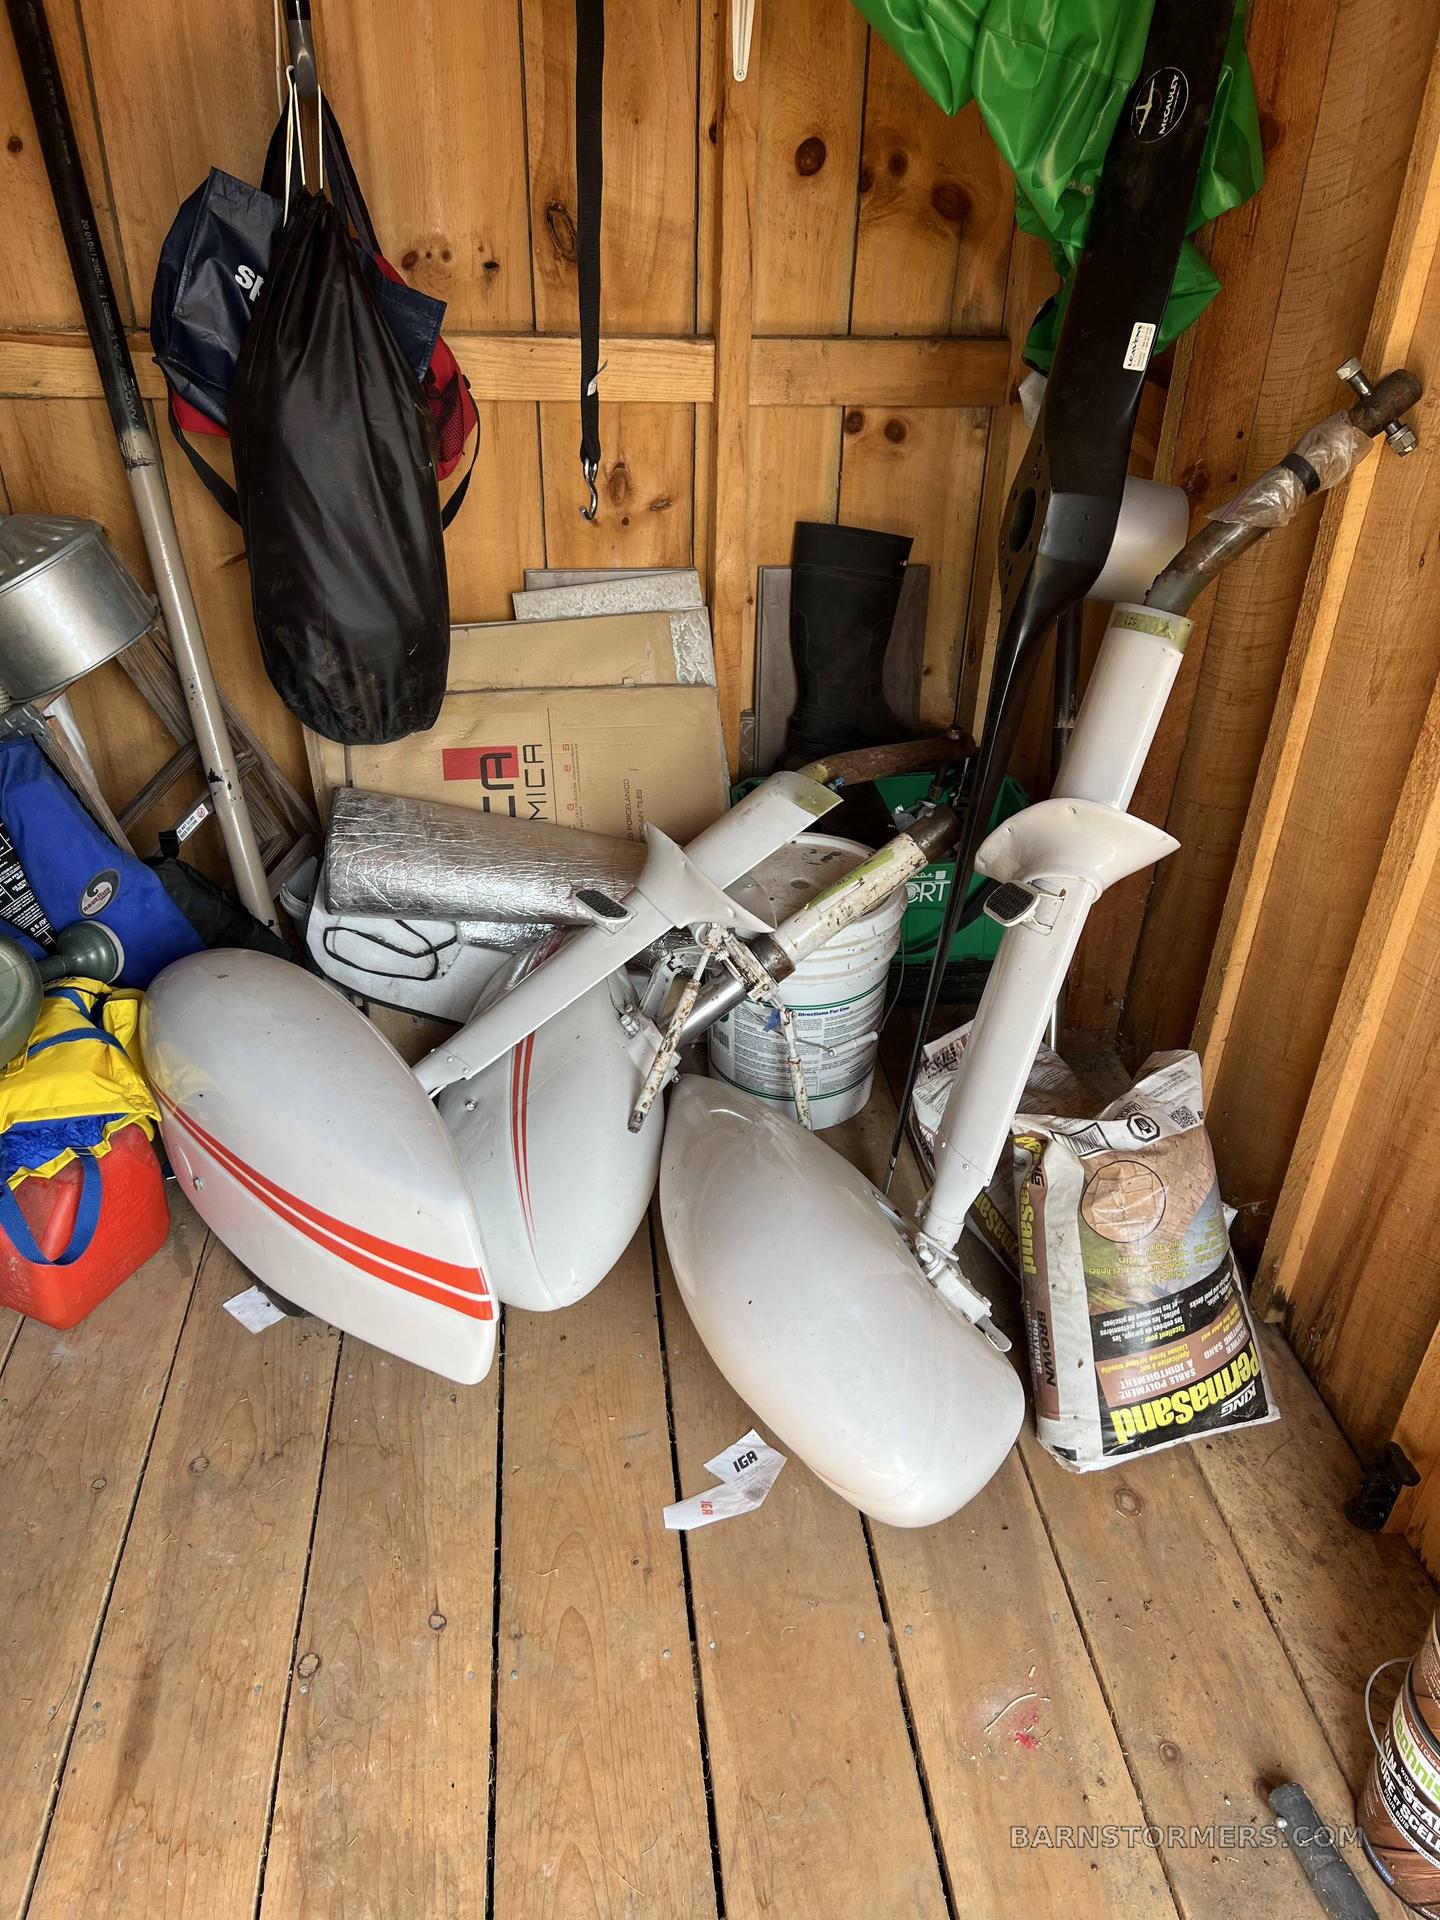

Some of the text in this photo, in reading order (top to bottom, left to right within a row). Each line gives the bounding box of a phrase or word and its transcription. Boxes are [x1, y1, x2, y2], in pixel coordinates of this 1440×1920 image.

[1088, 1268, 1111, 1277] herbes
[1162, 1303, 1171, 1312] les
[1189, 1296, 1205, 1309] decks
[1102, 1314, 1127, 1328] piscines
[1151, 1316, 1161, 1325] les
[1174, 1316, 1183, 1324] les
[1112, 1335, 1122, 1343] les
[1144, 1332, 1158, 1343] pour
[1158, 1324, 1185, 1340] Excellent
[1031, 1319, 1043, 1375] POLYMER
[1037, 1309, 1056, 1388] BROWN
[1203, 1340, 1223, 1360] SAND
[1120, 1362, 1185, 1390] JOINTOIEMENT
[1167, 1367, 1197, 1386] SABLE
[1220, 1381, 1257, 1418] KING
[732, 1449, 759, 1473] IGA
[1395, 1810, 1410, 1831] BOIS
